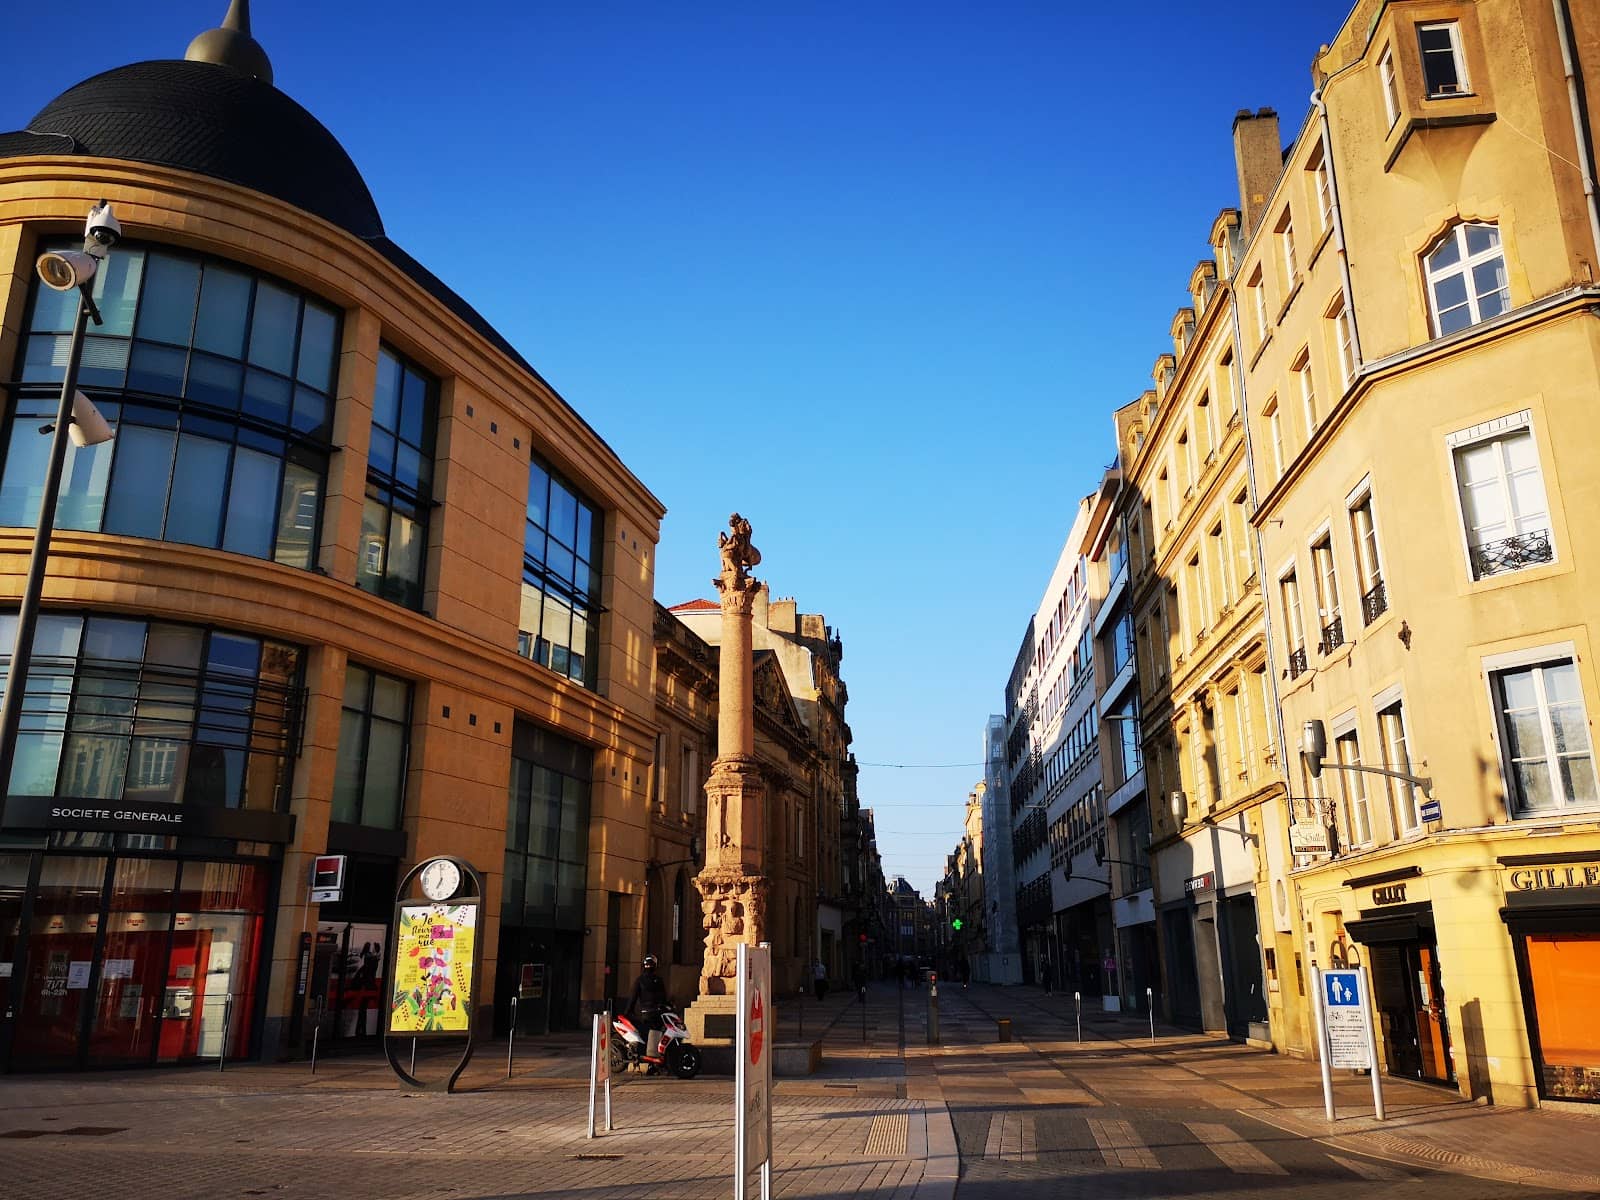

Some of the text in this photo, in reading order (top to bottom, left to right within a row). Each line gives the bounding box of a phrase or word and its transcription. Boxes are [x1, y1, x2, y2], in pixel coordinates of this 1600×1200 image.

[52, 808, 183, 823] SOCIETE GENERALE
[1372, 883, 1407, 905] GILLET
